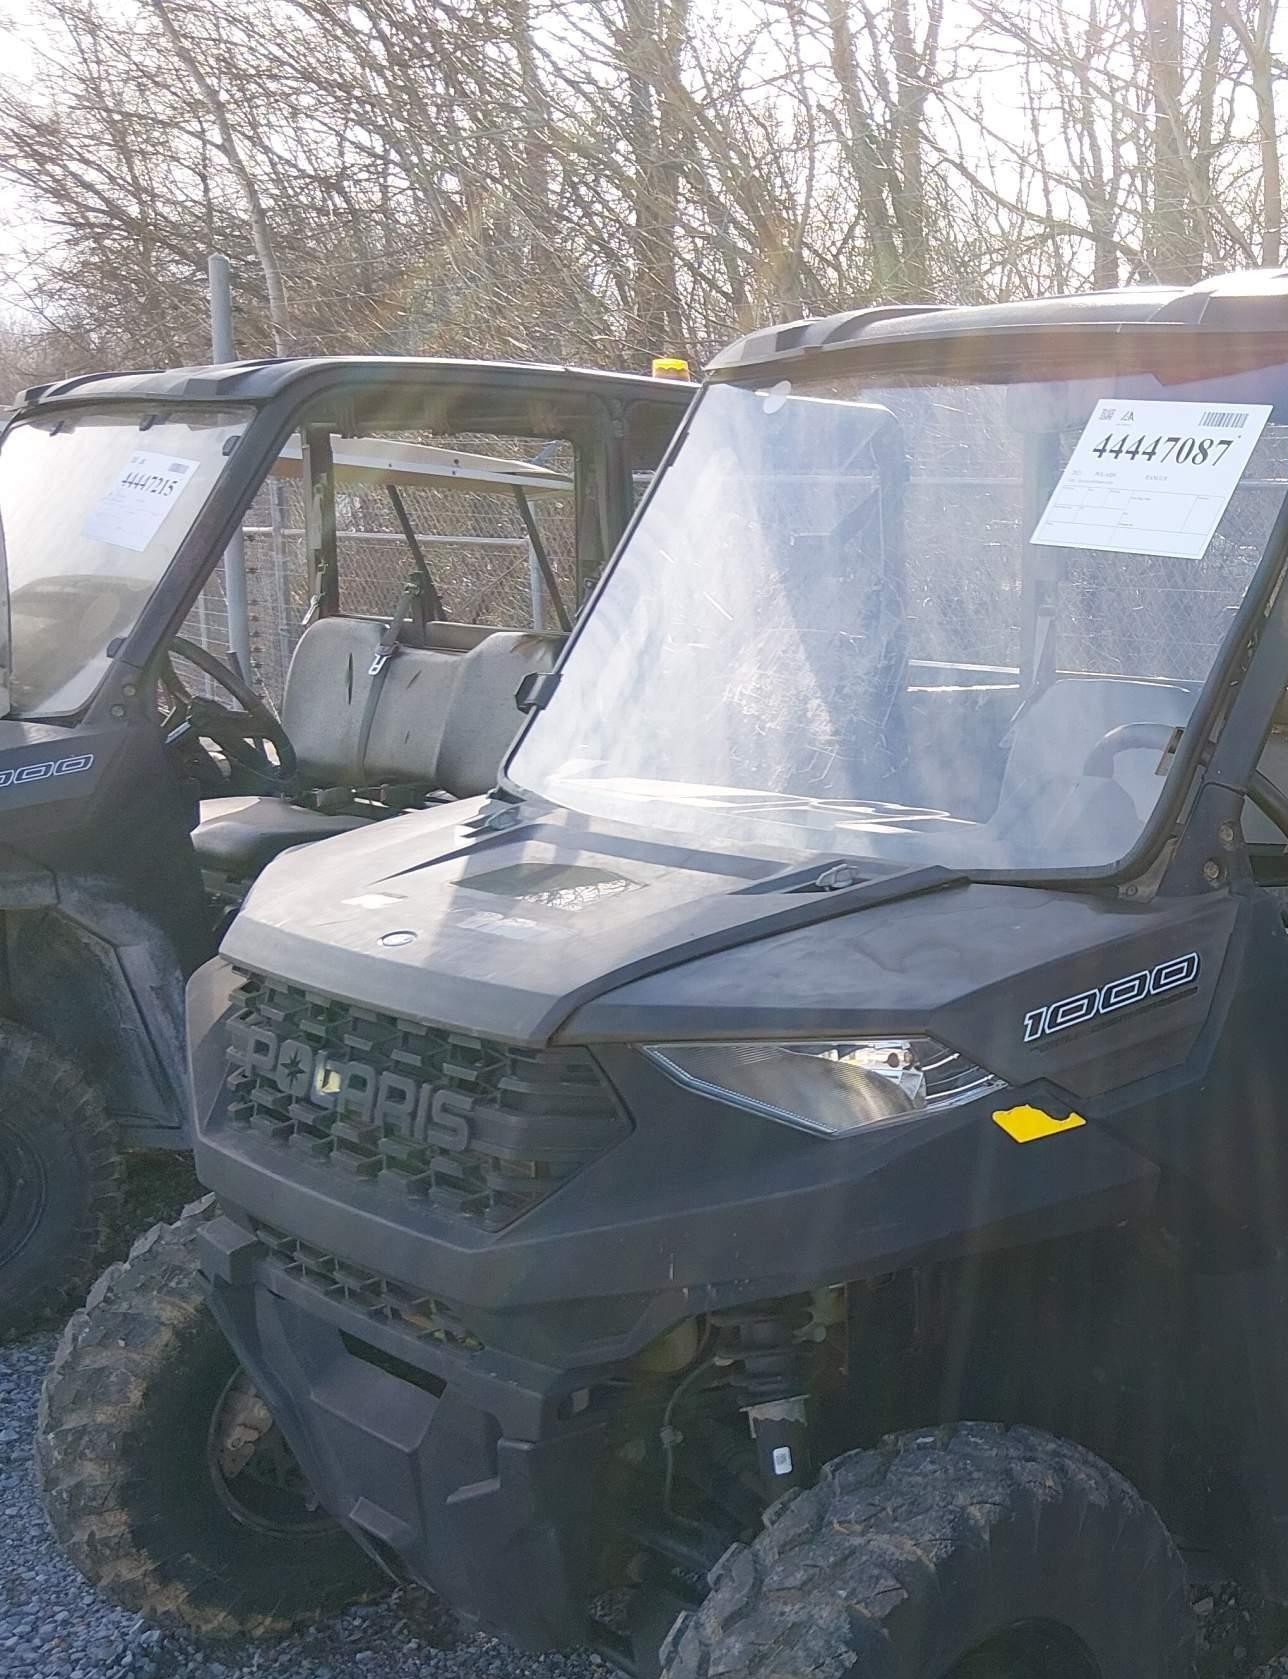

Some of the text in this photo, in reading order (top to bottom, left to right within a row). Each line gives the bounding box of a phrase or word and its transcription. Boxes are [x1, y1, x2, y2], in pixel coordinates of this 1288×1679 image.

[1092, 433, 1234, 467] 44447087
[121, 471, 179, 497] 44447215
[1023, 951, 1200, 1042] 1000
[246, 1023, 473, 1153] POLARIS
